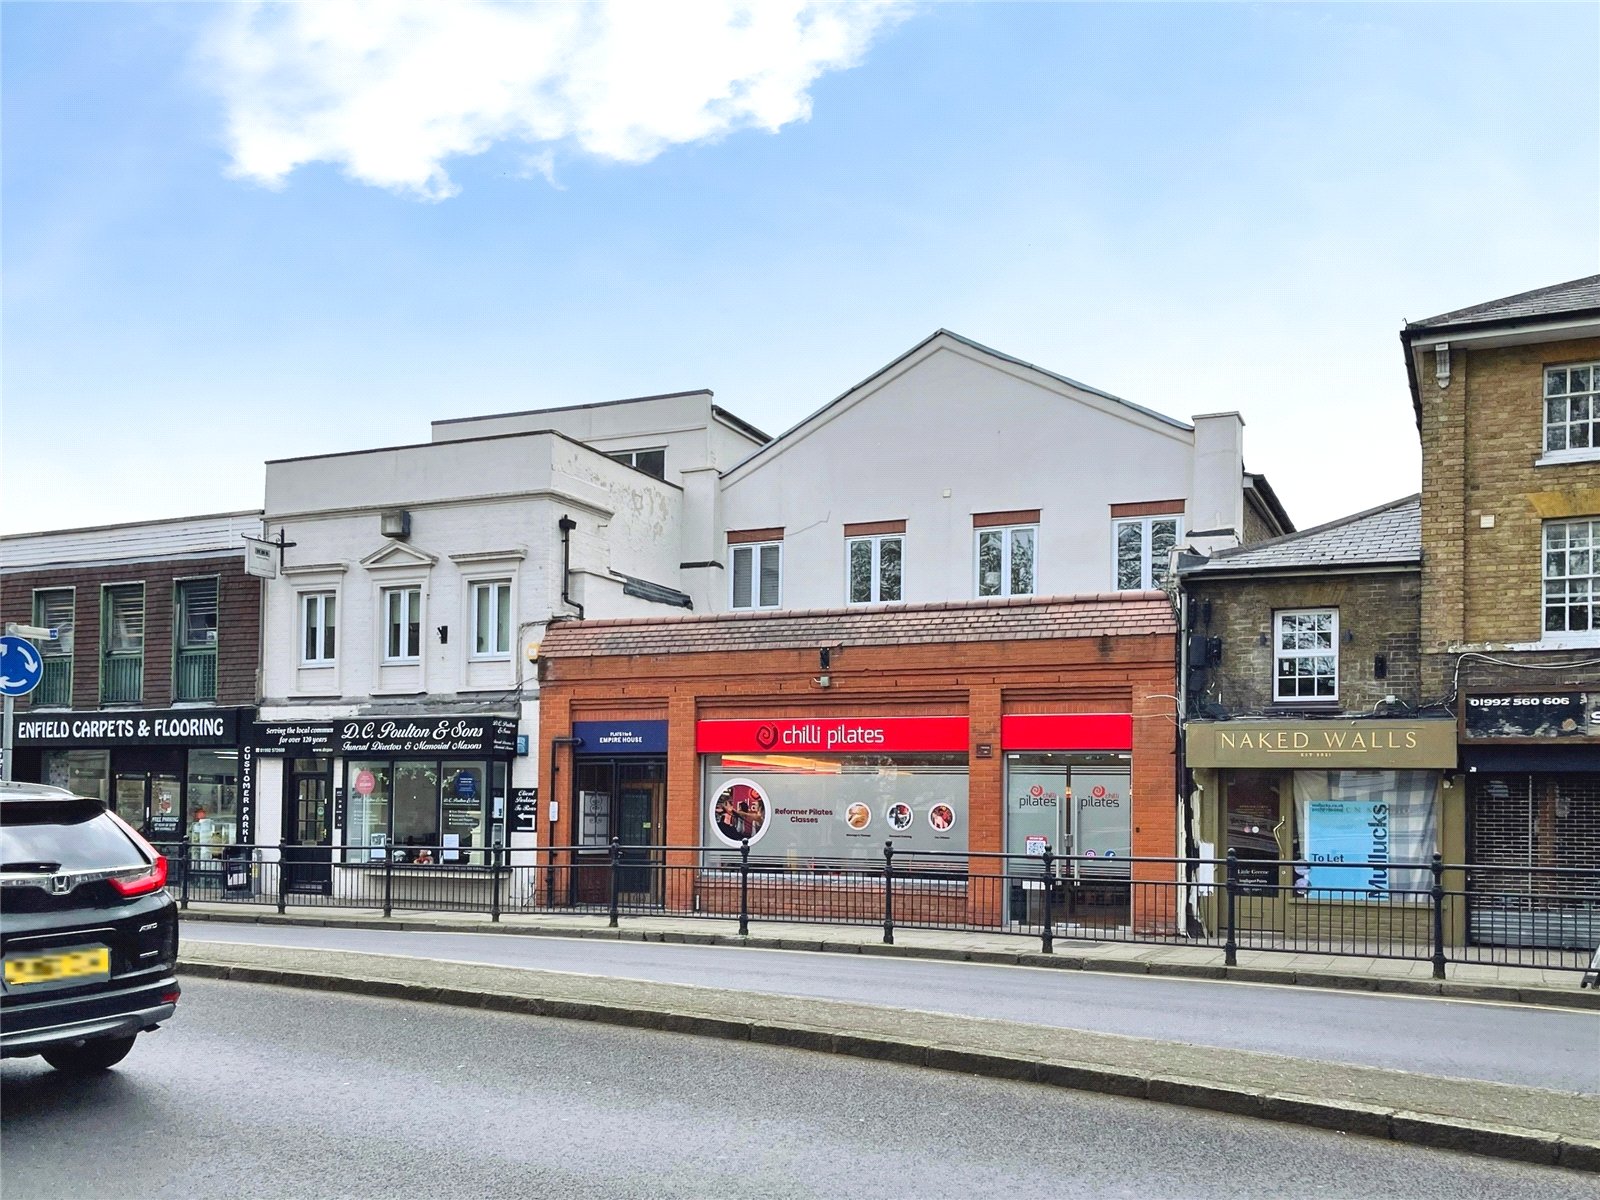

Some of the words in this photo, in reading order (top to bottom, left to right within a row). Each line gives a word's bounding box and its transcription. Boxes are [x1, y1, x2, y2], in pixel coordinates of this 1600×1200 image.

[1470, 698, 1511, 706] 01992
[1512, 698, 1540, 706] 560
[1542, 697, 1570, 705] 606
[18, 721, 70, 738] ENFIELD
[72, 720, 134, 738] CARPETS
[137, 720, 151, 737] &
[154, 718, 224, 736] FLOORING
[266, 727, 287, 736] Serving
[296, 726, 311, 734] local
[341, 721, 374, 739] D.C.
[377, 721, 430, 739] Poulton
[432, 720, 450, 740] &
[450, 720, 484, 738] Sons
[278, 736, 288, 745] for
[312, 737, 328, 745] years
[599, 736, 621, 744] EMPIRE
[783, 724, 821, 744] chilli
[827, 724, 884, 749] pilates
[1221, 732, 1309, 749] NAKED
[1324, 731, 1417, 749] WALLS
[341, 741, 370, 751] Funeral
[370, 741, 402, 751] Directors
[404, 741, 412, 751] &
[413, 740, 451, 750] Memorial
[451, 740, 482, 750] Masons
[242, 746, 251, 804] CUSTOMER
[515, 797, 536, 805] Parking
[1019, 794, 1057, 809] pilates
[1080, 795, 1120, 810] pilates
[775, 808, 807, 816] Reformer
[809, 808, 833, 816] Pilates
[790, 816, 819, 824] Classes
[1312, 853, 1324, 863] To
[1327, 854, 1344, 863] Let
